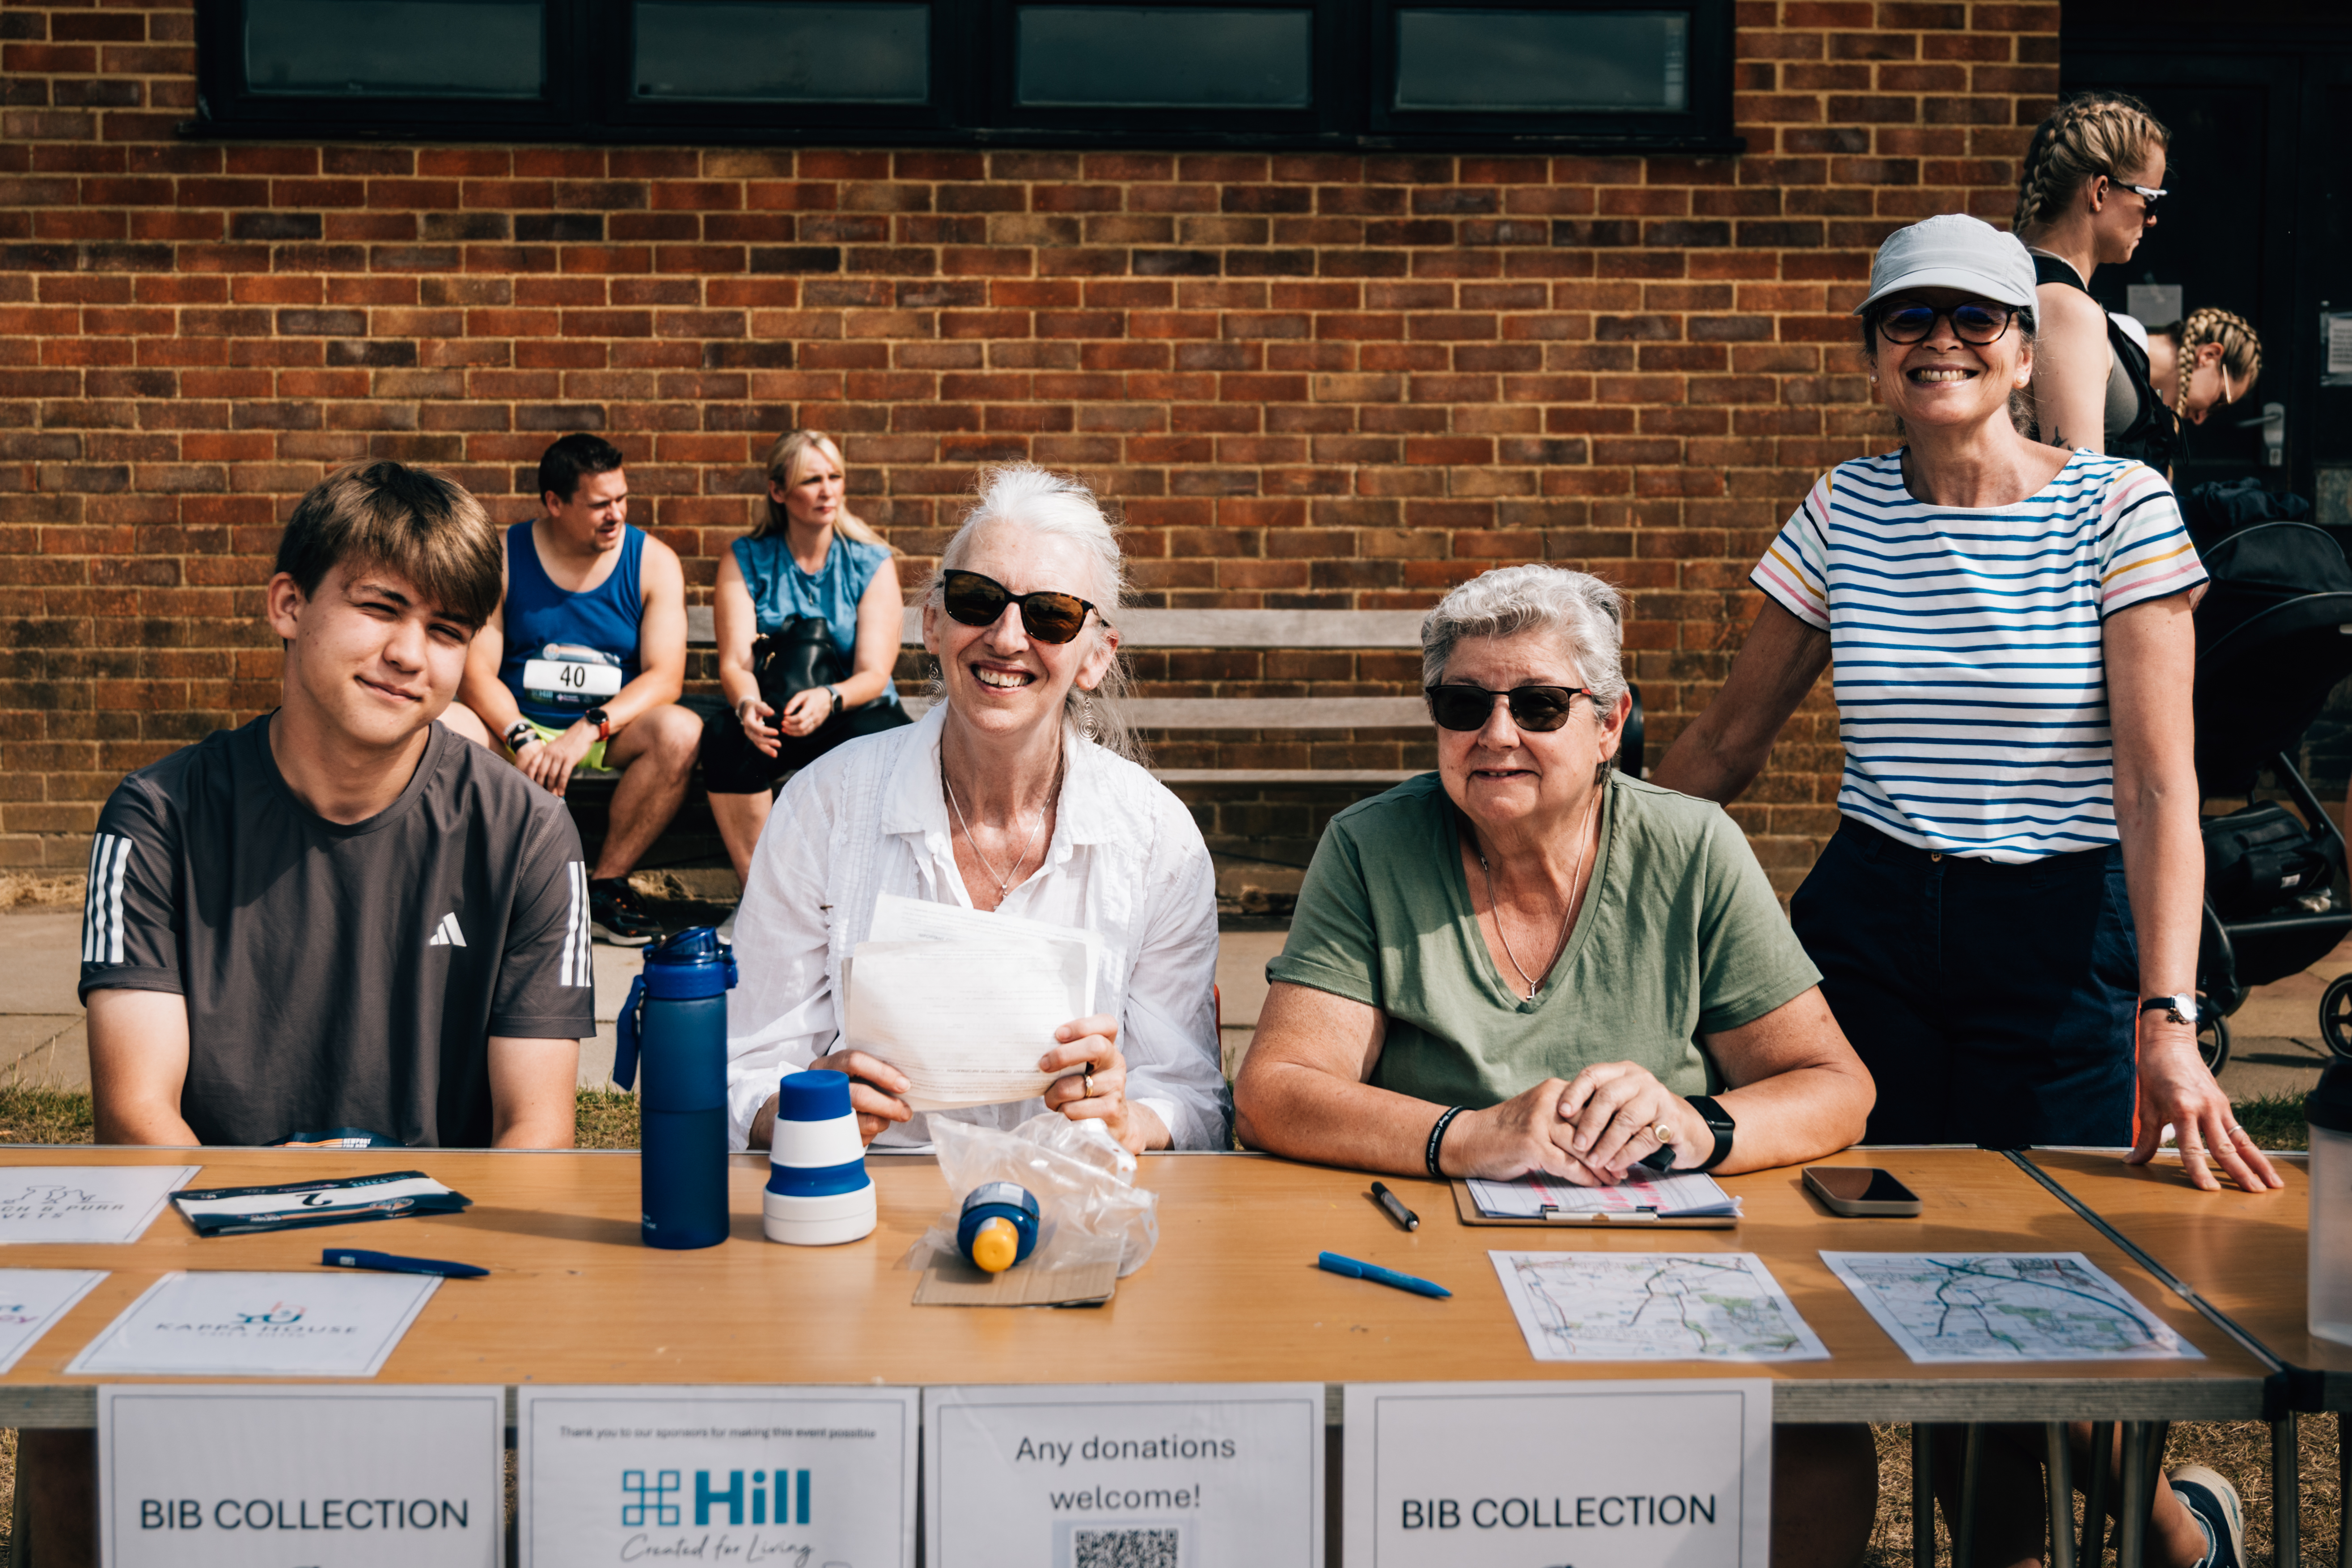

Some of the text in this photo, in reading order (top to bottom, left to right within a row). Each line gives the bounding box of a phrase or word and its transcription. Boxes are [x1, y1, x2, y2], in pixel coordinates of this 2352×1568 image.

[560, 664, 585, 688] 40
[296, 1192, 333, 1206] 2
[156, 1323, 358, 1335] KAPPA HOUSE
[560, 1425, 877, 1441] Thank you to our sponsors for making this event possible
[1015, 1434, 1236, 1467] Any donations
[694, 1469, 811, 1526] Hill
[1049, 1483, 1201, 1511] welcome!
[1402, 1493, 1717, 1530] BIB COLLECTION
[140, 1498, 469, 1530] BIB COLLECTION
[620, 1533, 816, 1568] Created for Living
